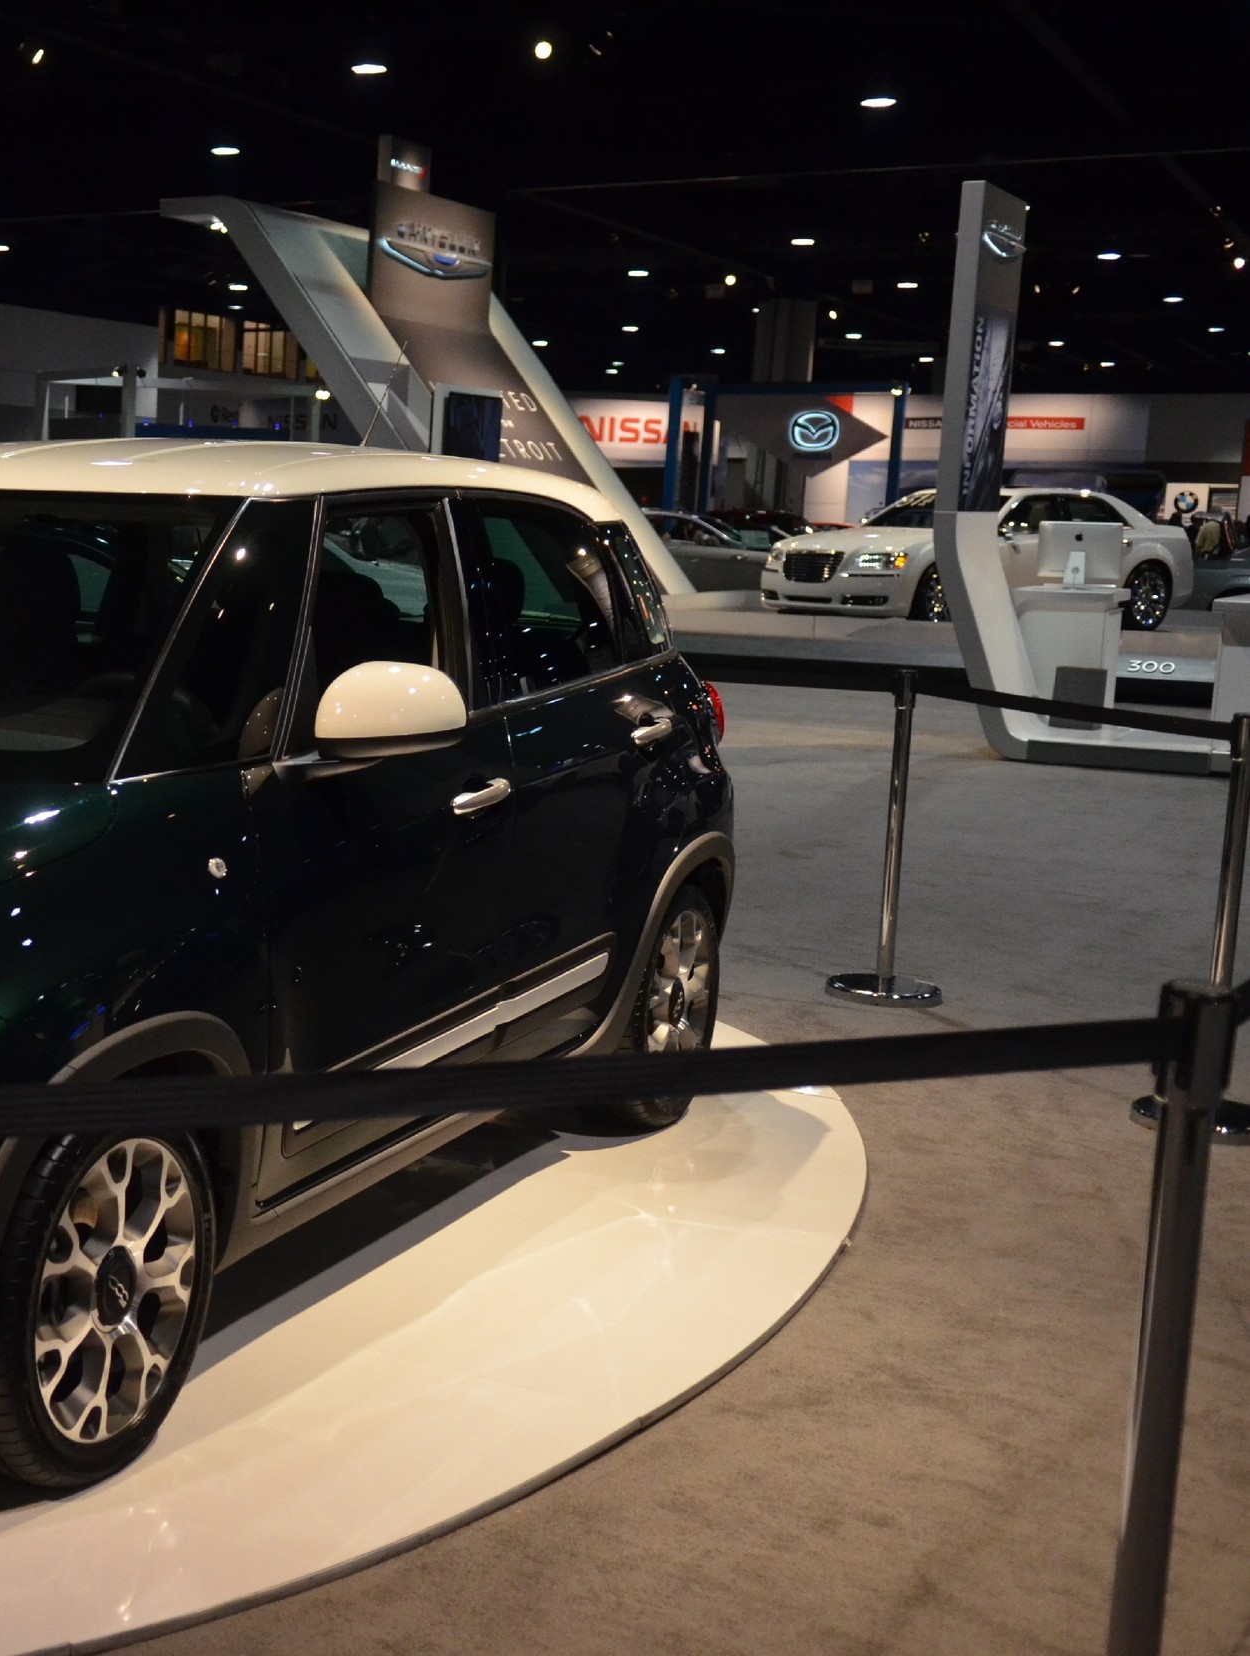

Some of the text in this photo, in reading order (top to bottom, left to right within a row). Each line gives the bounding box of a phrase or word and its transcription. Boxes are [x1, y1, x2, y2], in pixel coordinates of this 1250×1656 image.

[962, 317, 984, 495] INFORMATION
[1030, 419, 1077, 429] Vehicles
[499, 439, 562, 461] TROIT
[1127, 659, 1176, 674] 300
